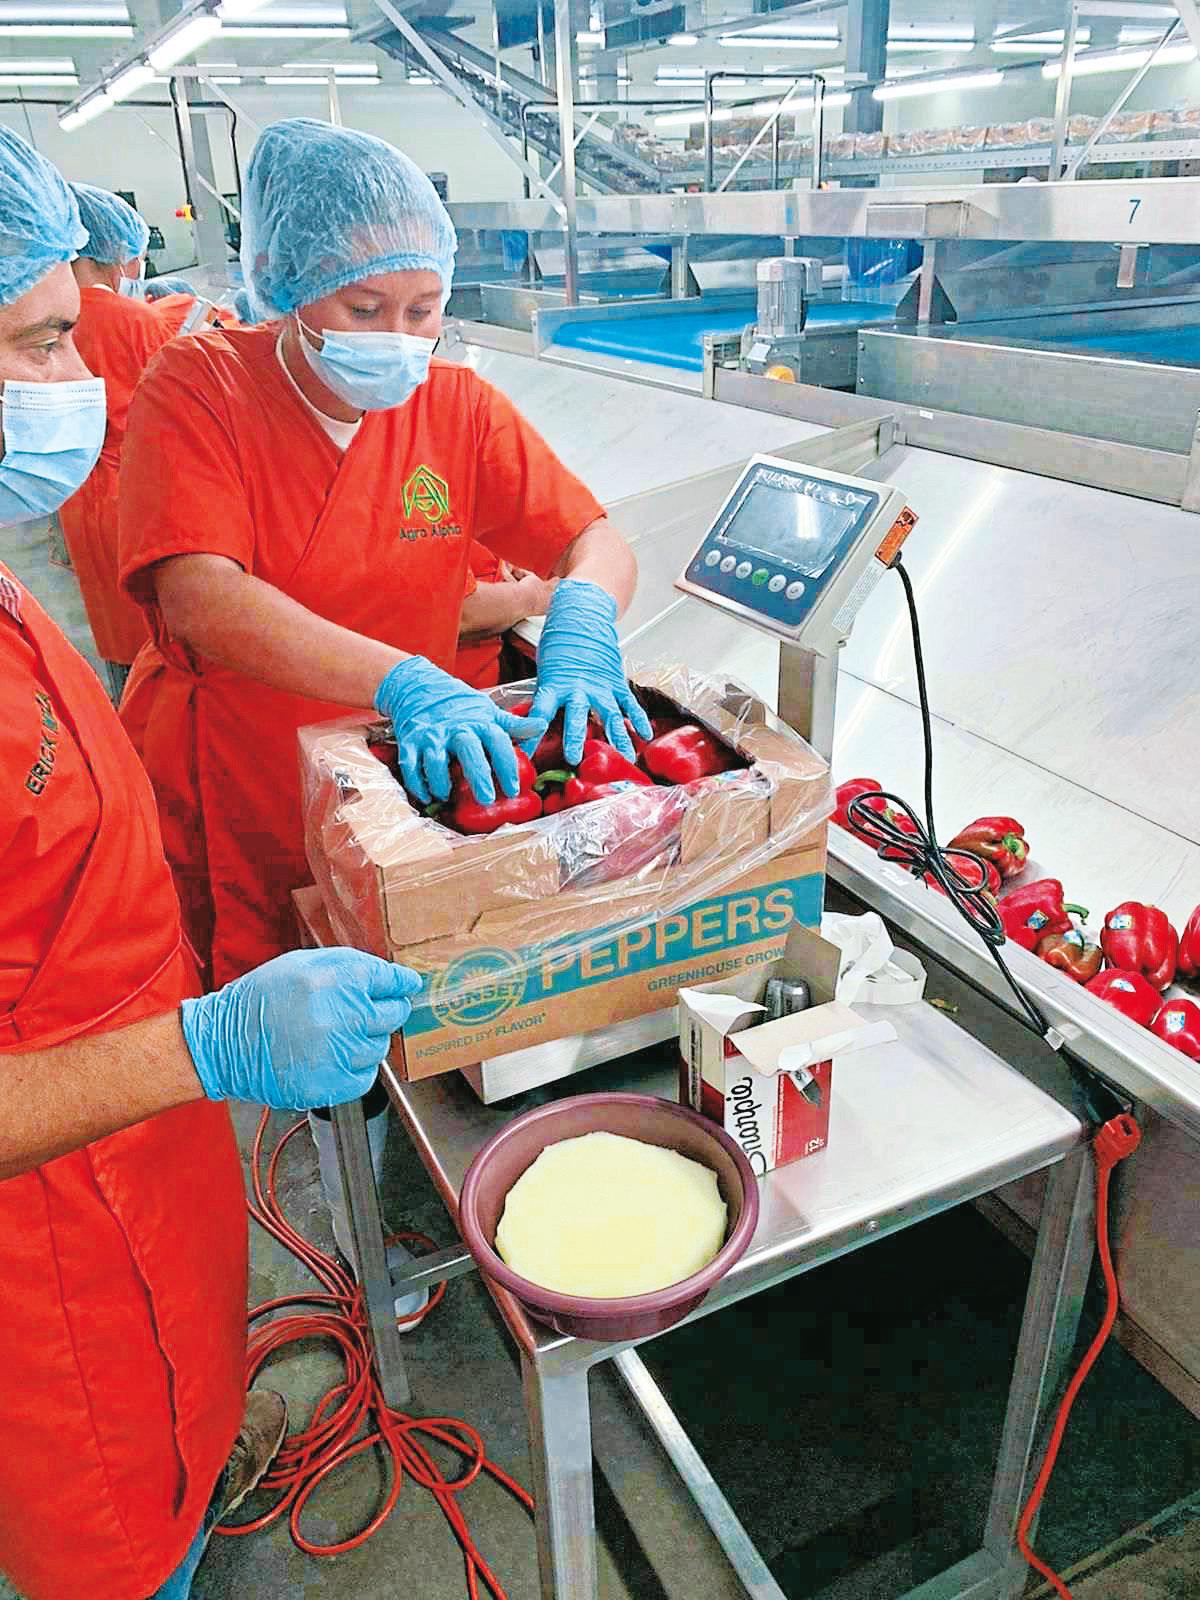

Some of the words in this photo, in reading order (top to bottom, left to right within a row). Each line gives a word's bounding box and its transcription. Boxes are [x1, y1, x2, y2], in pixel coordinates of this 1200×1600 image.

[1128, 199, 1141, 224] 7
[399, 527, 427, 541] Agro
[26, 733, 58, 796] ERICK
[541, 888, 795, 991] PEPPERS
[647, 958, 743, 992] GREENHOUSE
[744, 947, 786, 967] GROW
[434, 981, 524, 1018] SUNSET
[416, 1036, 473, 1059] INSPIRED
[475, 1029, 493, 1042] BY
[808, 1137, 820, 1153] 12
